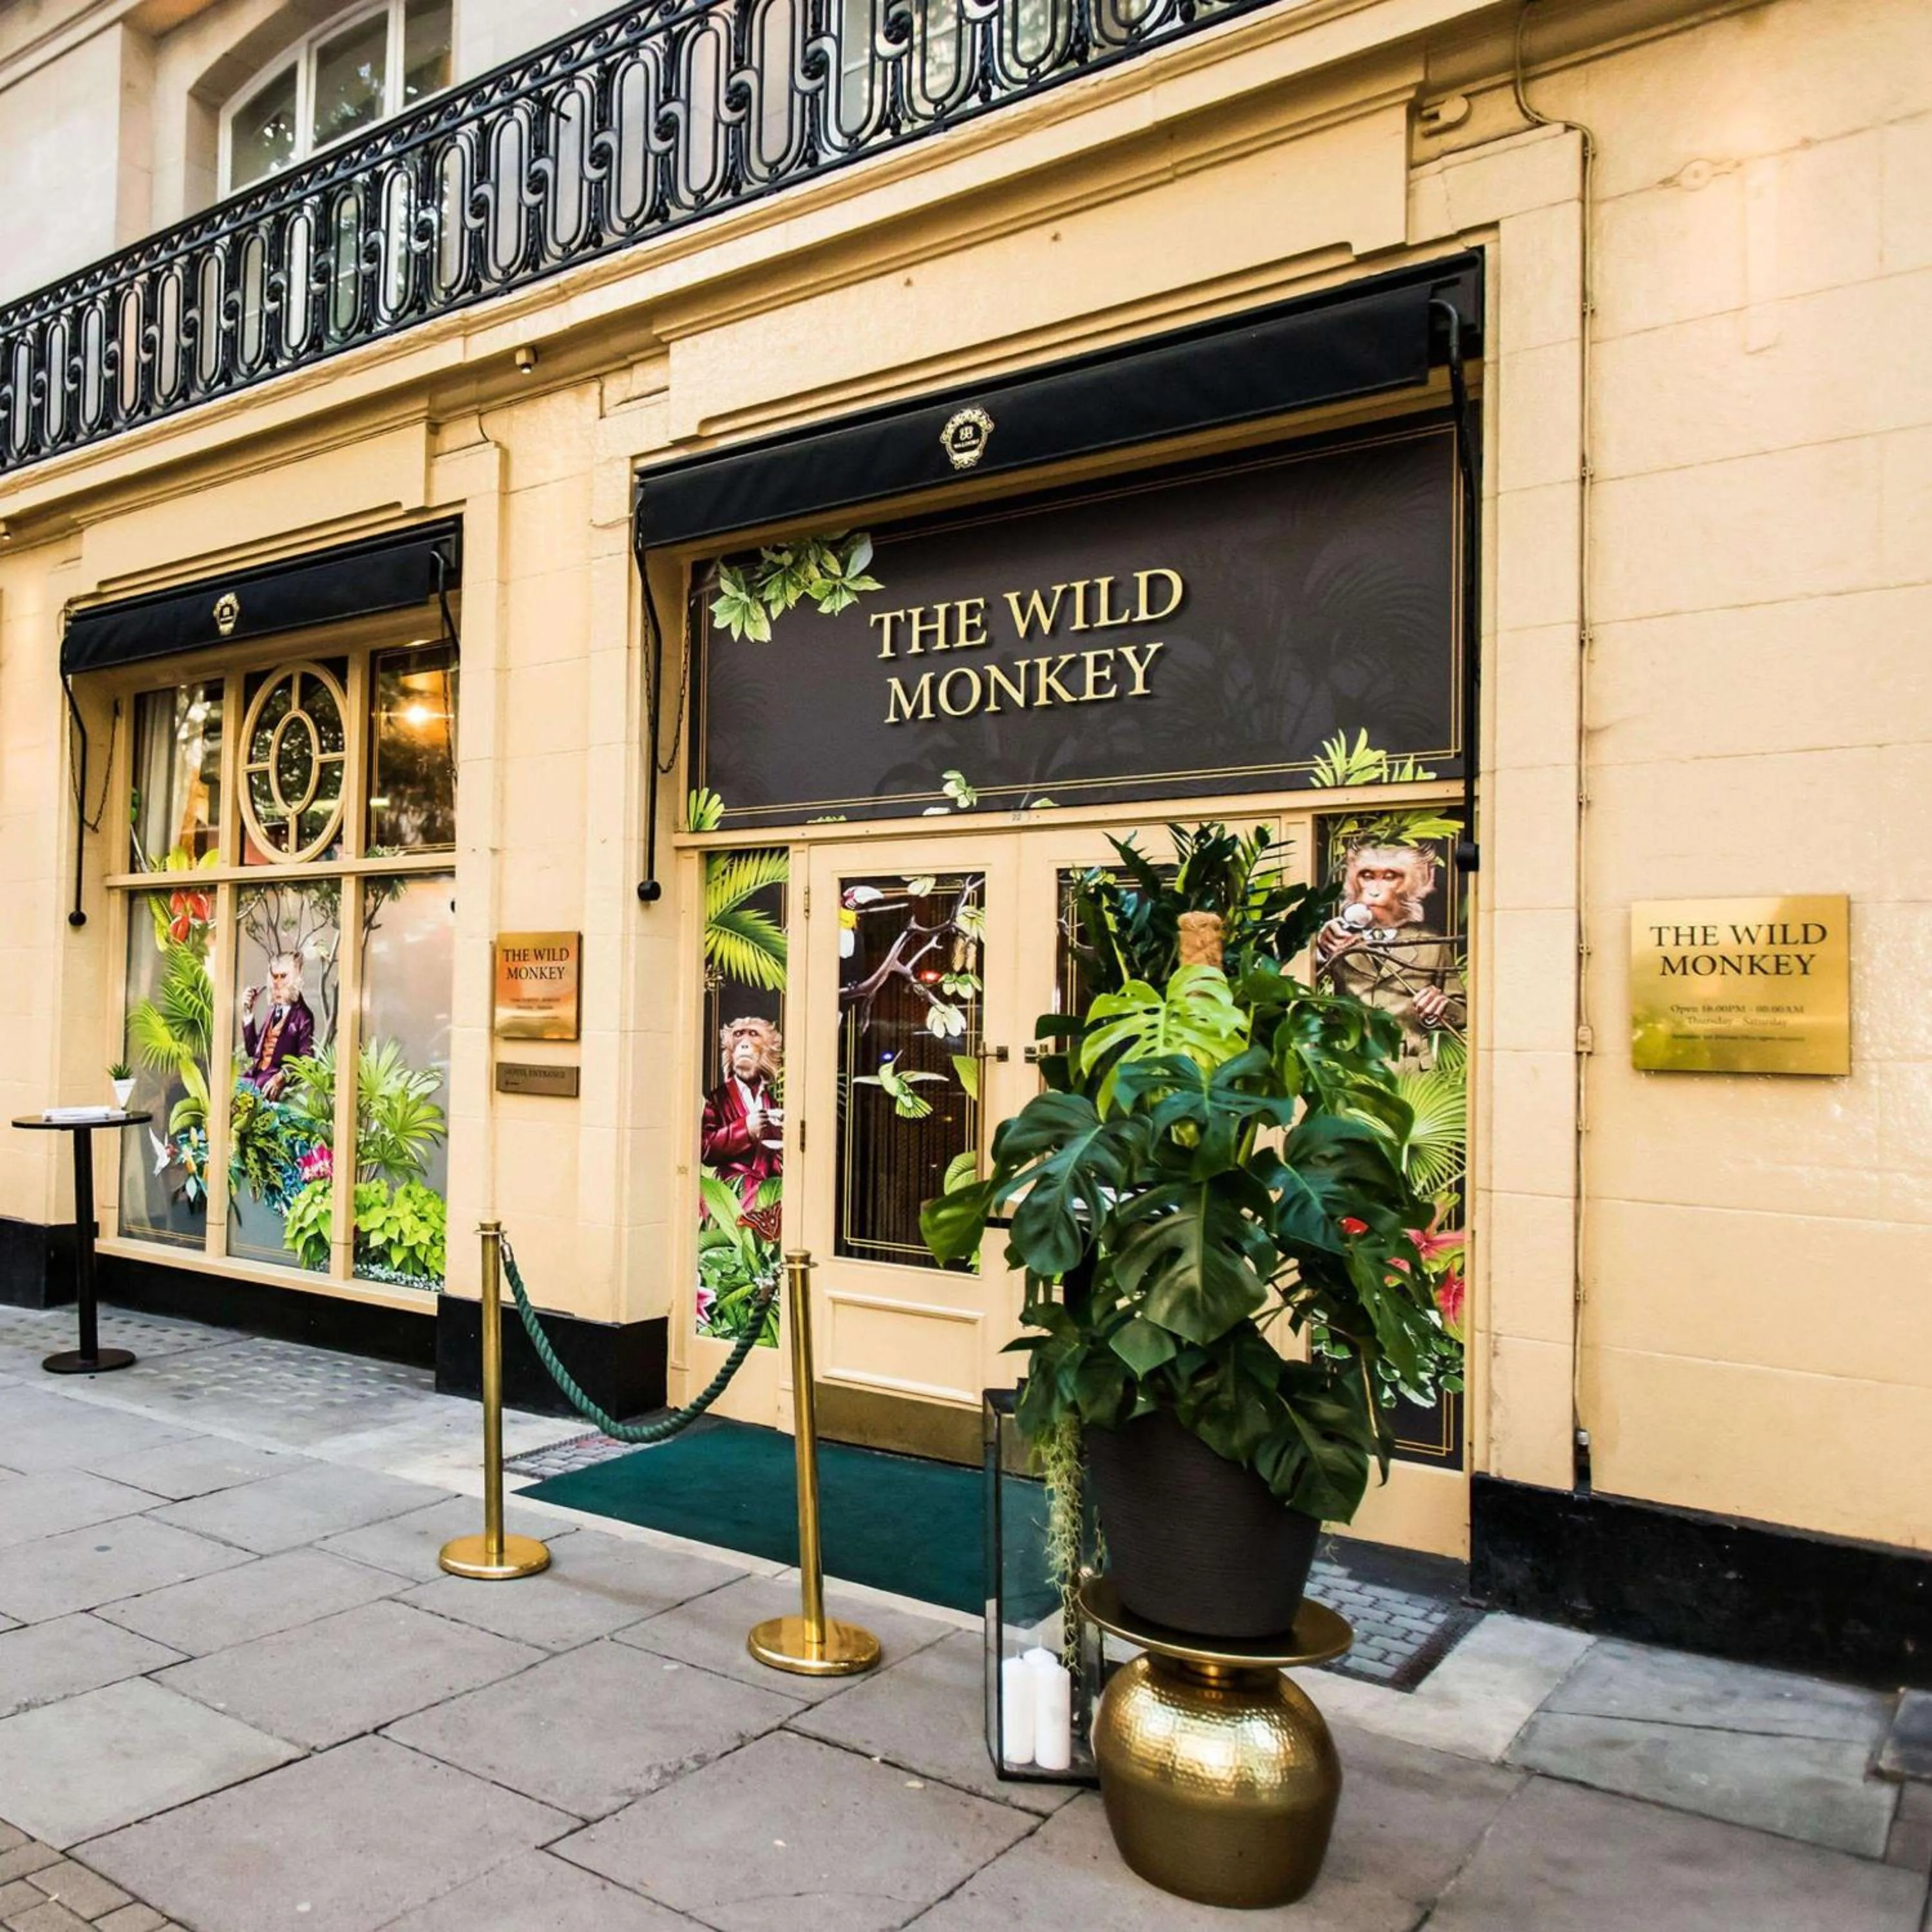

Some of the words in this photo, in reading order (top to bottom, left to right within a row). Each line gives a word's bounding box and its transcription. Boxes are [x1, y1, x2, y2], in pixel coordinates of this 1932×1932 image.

[869, 597, 988, 659] THE
[1003, 567, 1184, 639] WILD
[884, 642, 1164, 723] MONKEY
[1649, 925, 1720, 947] THE
[1728, 923, 1828, 945] WILD
[503, 949, 530, 962] THE
[533, 947, 570, 962] WILD
[1660, 954, 1817, 976] MONKEY
[506, 967, 565, 980] MONKEY
